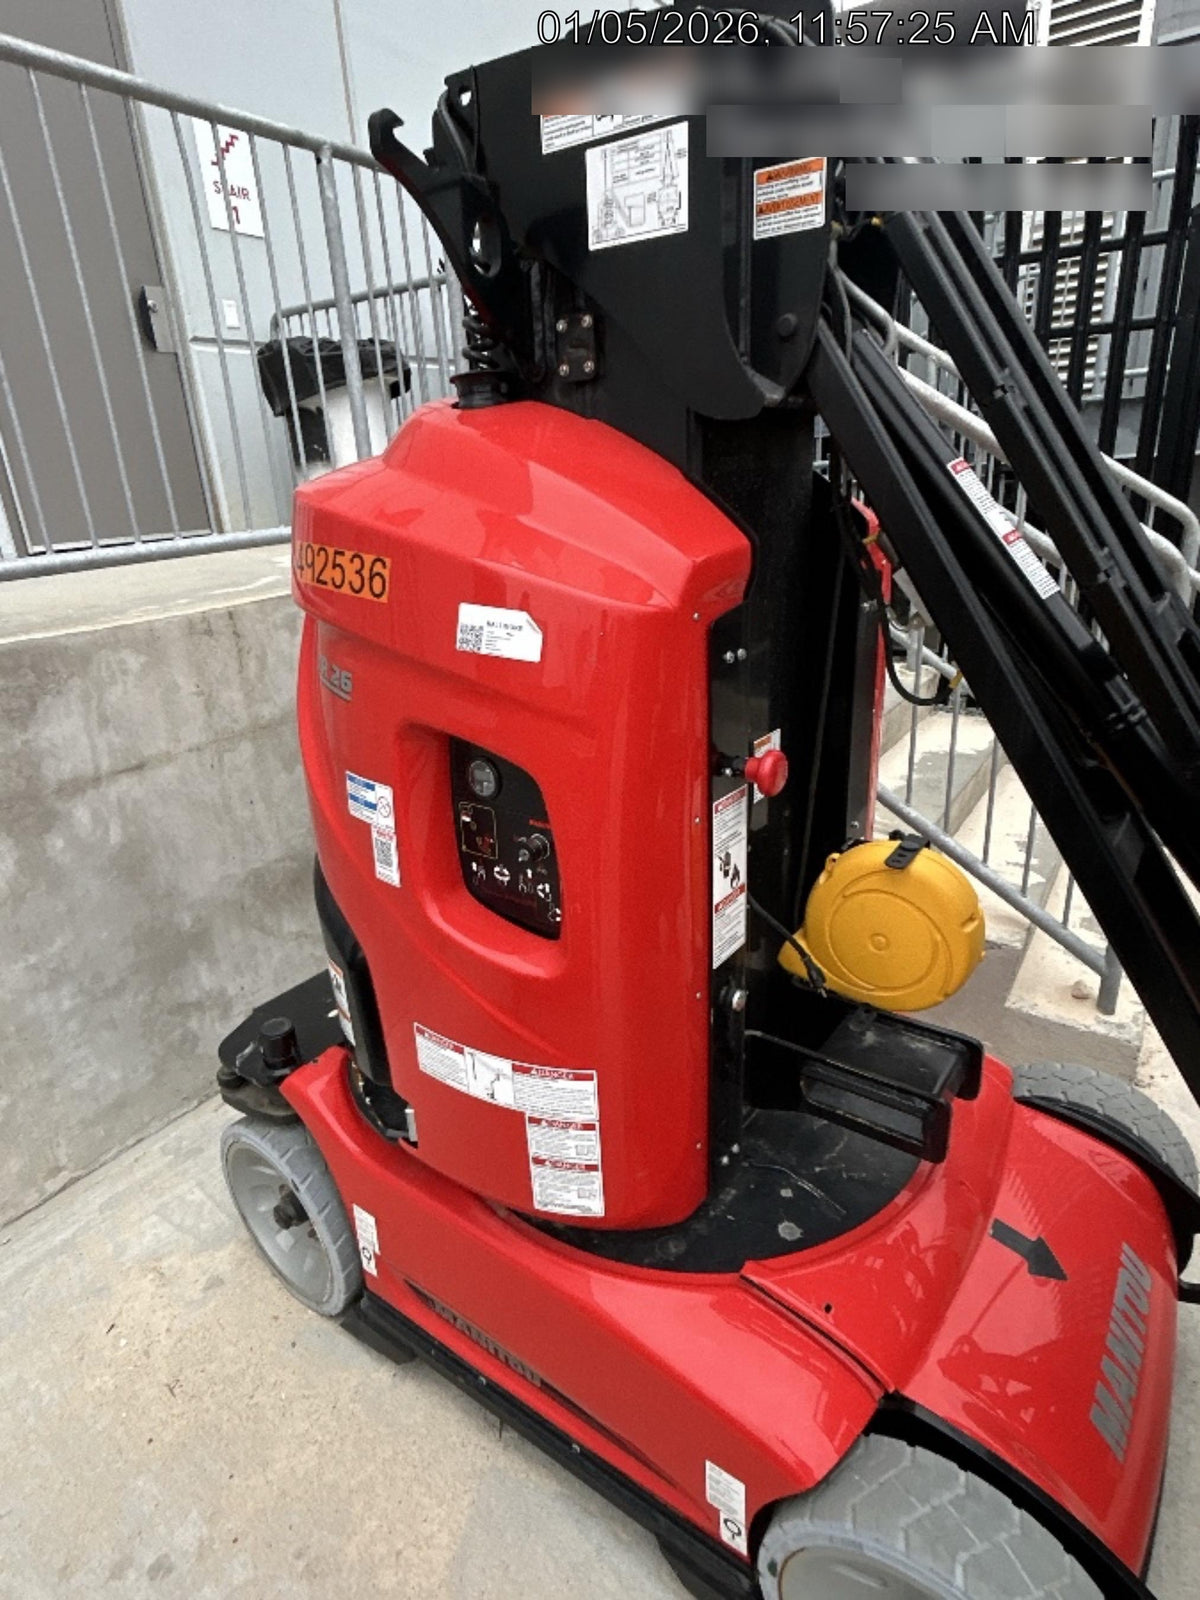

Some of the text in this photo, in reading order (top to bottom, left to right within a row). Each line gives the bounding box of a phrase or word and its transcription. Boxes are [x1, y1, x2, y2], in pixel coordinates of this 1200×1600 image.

[213, 180, 250, 201] SAIR
[232, 206, 240, 224] 1
[1089, 1241, 1153, 1463] MANITOU
